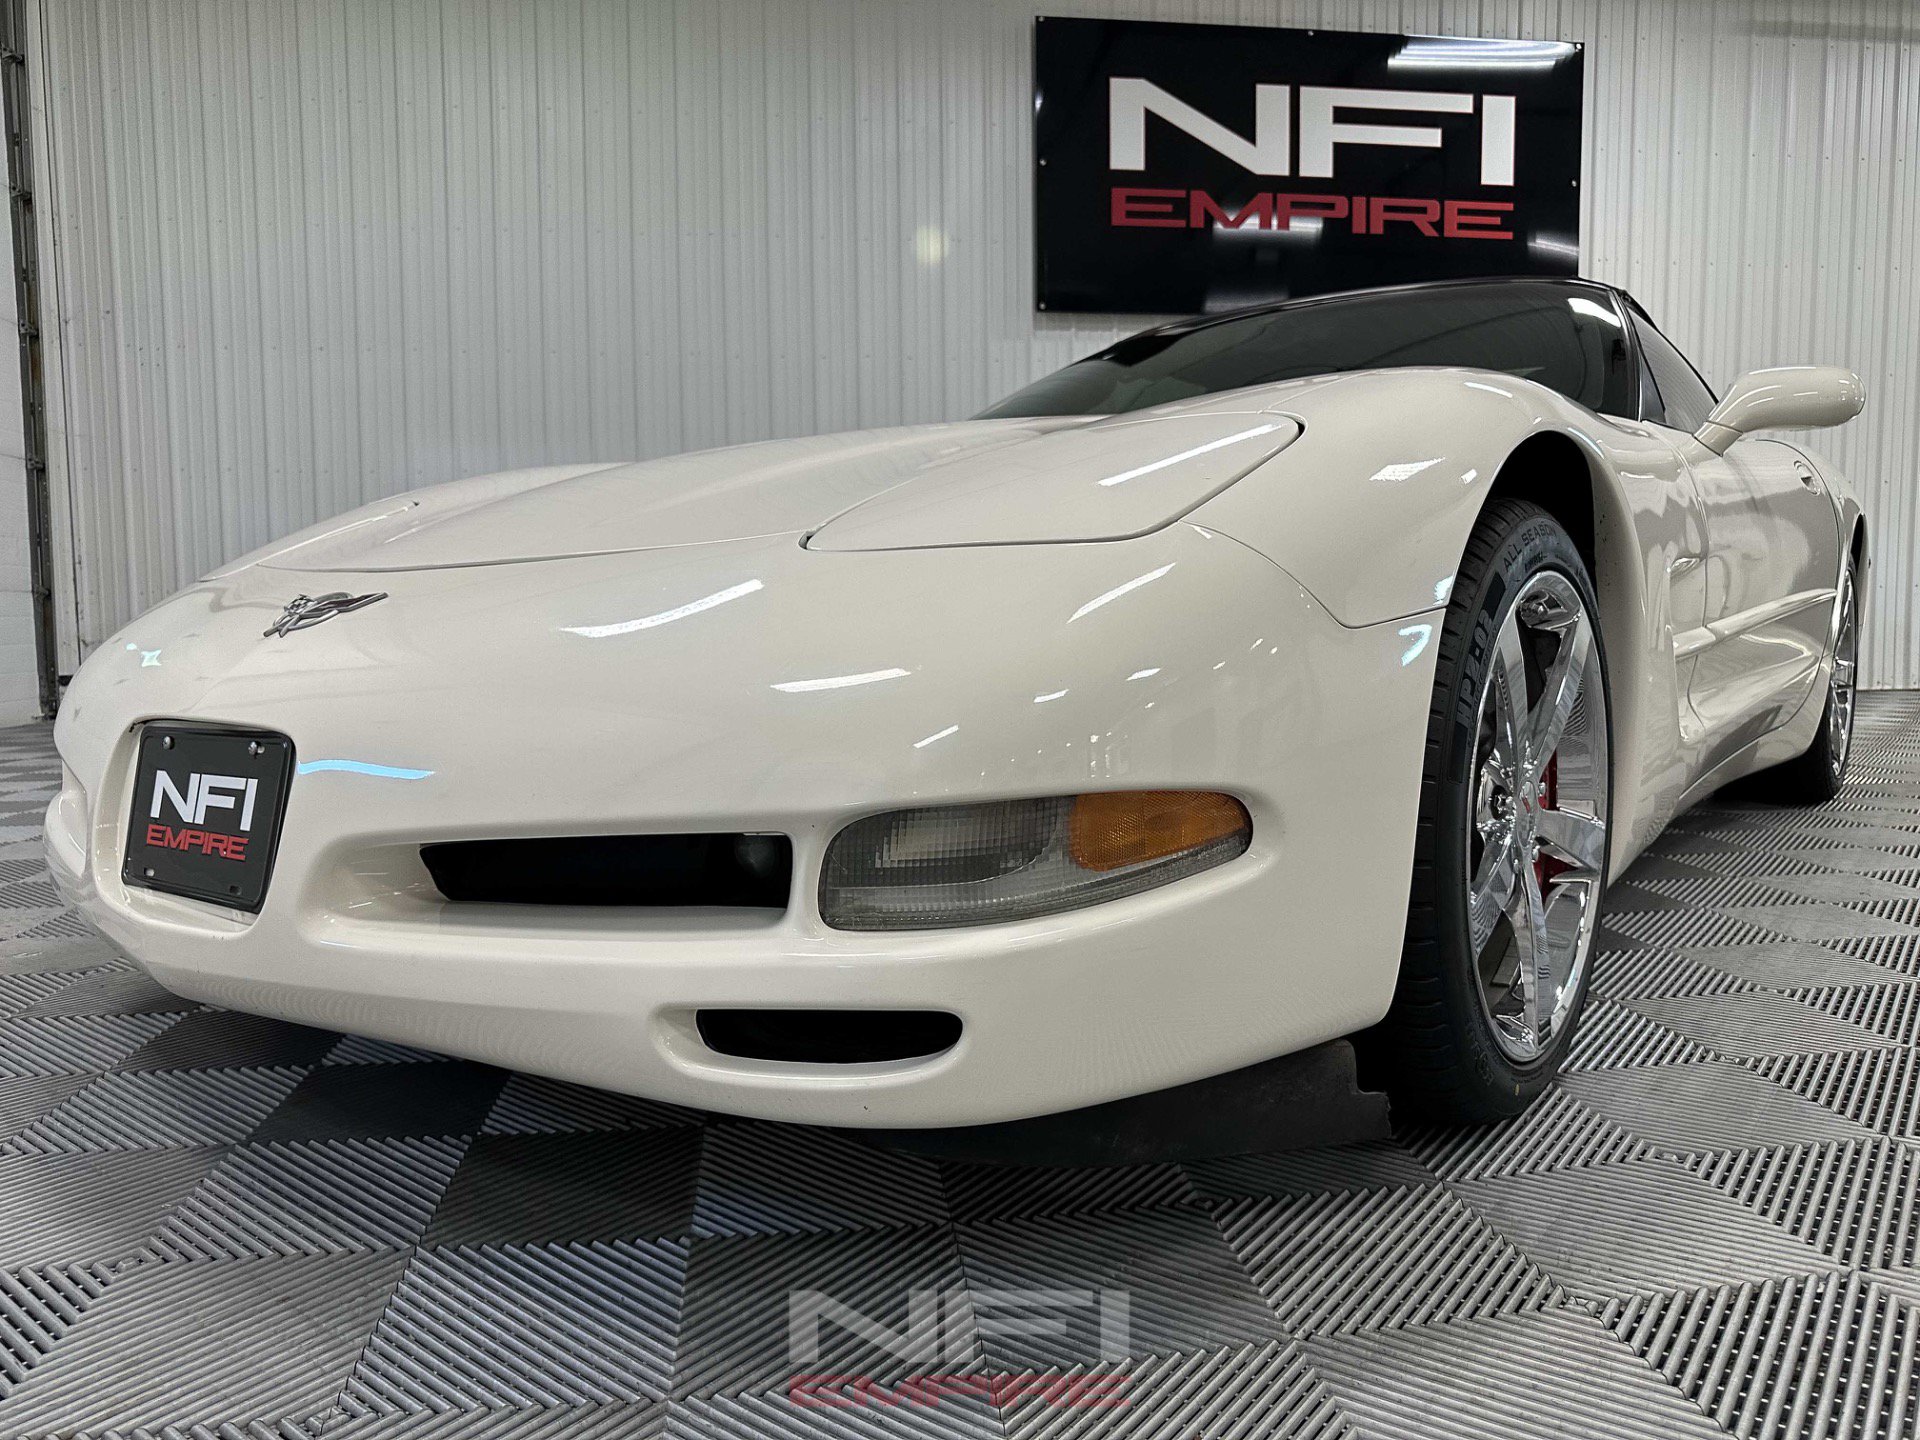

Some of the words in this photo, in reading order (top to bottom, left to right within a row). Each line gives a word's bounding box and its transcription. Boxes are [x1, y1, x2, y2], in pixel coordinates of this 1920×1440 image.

[1109, 76, 1516, 187] NFI
[1110, 187, 1514, 240] EMPIRE
[1503, 543, 1522, 573] ALL
[1521, 523, 1557, 546] SEASON
[149, 769, 259, 832] NFI
[146, 823, 250, 861] EMPIRE
